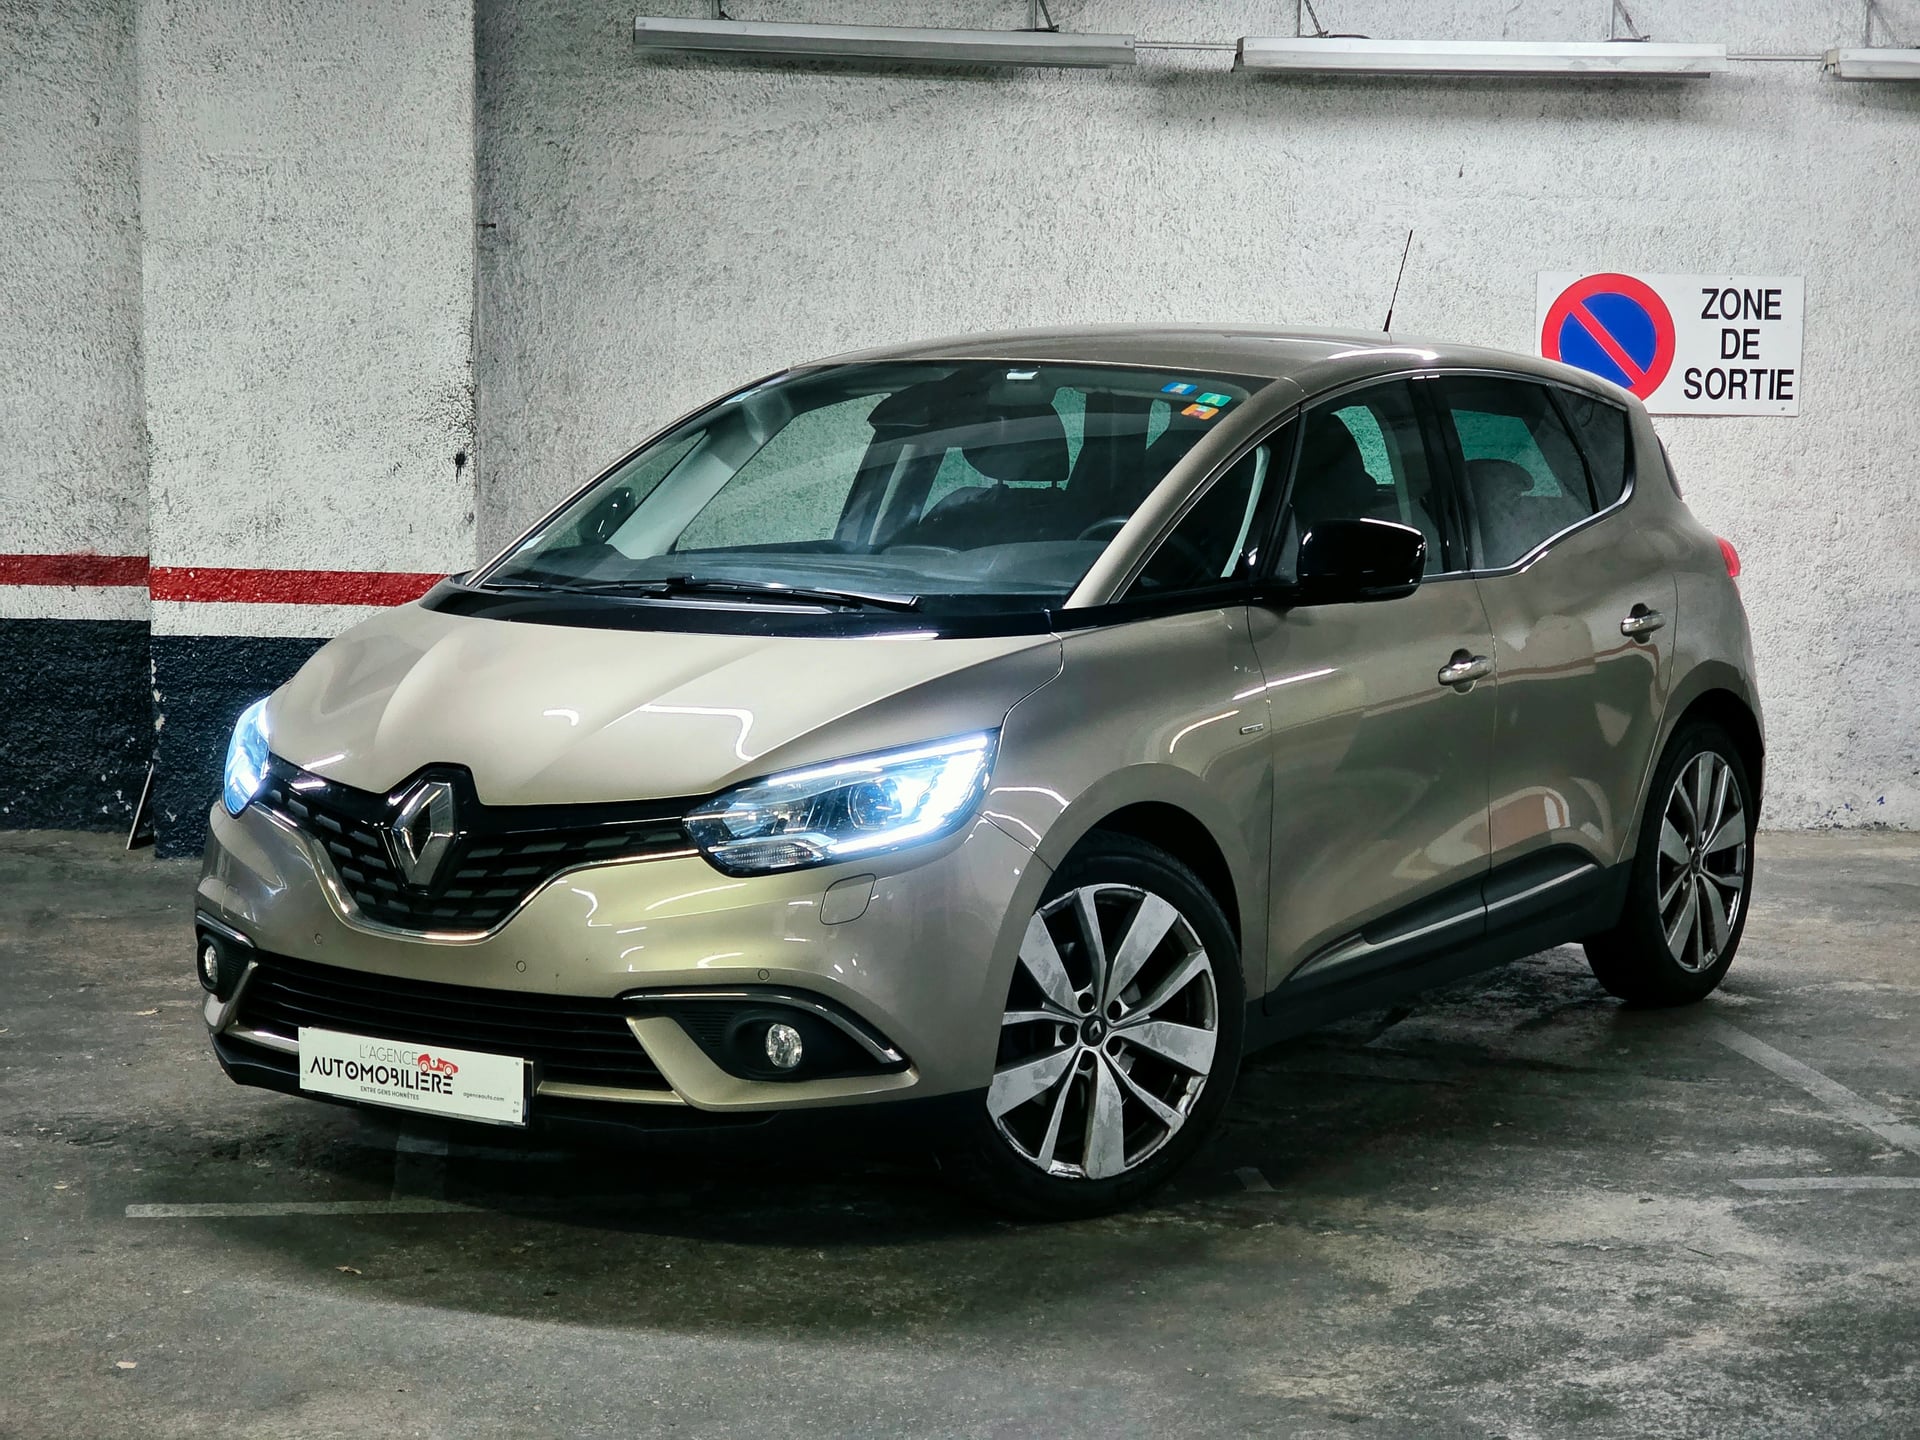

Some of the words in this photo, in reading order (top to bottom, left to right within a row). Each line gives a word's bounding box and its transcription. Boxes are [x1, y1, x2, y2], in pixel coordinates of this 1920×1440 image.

[1701, 288, 1782, 320] ZONE
[1720, 328, 1760, 360] DE
[1683, 367, 1794, 400] SORTIE
[359, 1044, 418, 1066] L'AGENCE
[360, 1086, 376, 1094] ENTRE
[377, 1088, 391, 1096] GENS
